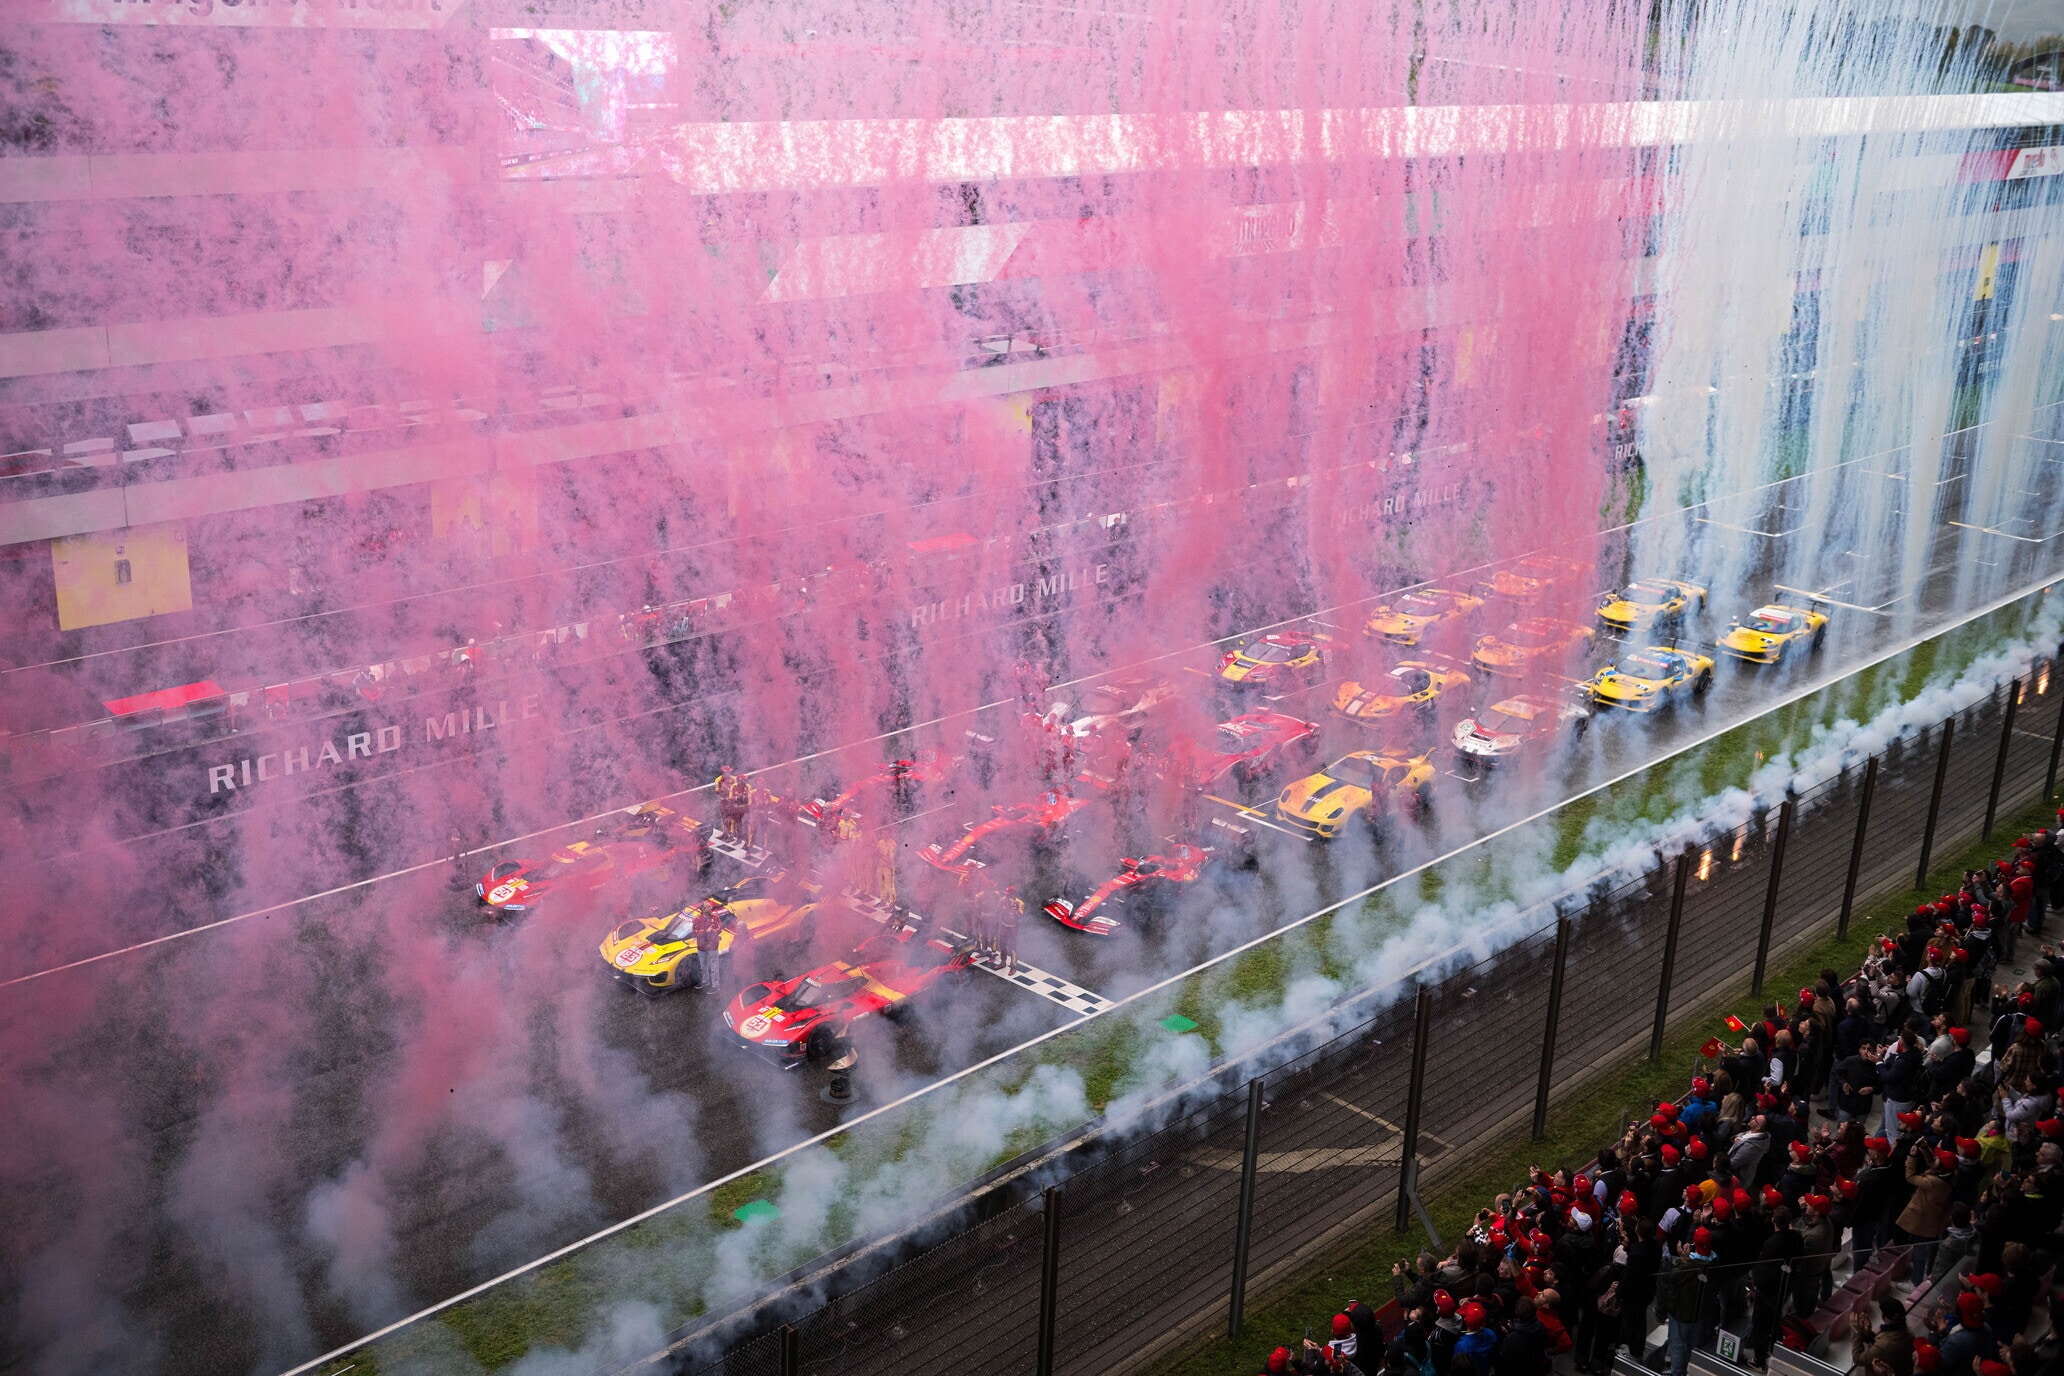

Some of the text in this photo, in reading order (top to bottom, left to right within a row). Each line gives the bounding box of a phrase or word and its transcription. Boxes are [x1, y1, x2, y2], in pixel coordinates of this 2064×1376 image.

[1415, 484, 1462, 508] MILLE
[912, 563, 1108, 628] RICHARD MILLE
[208, 694, 541, 794] RICHARD MILLE
[747, 1016, 769, 1031] 51
